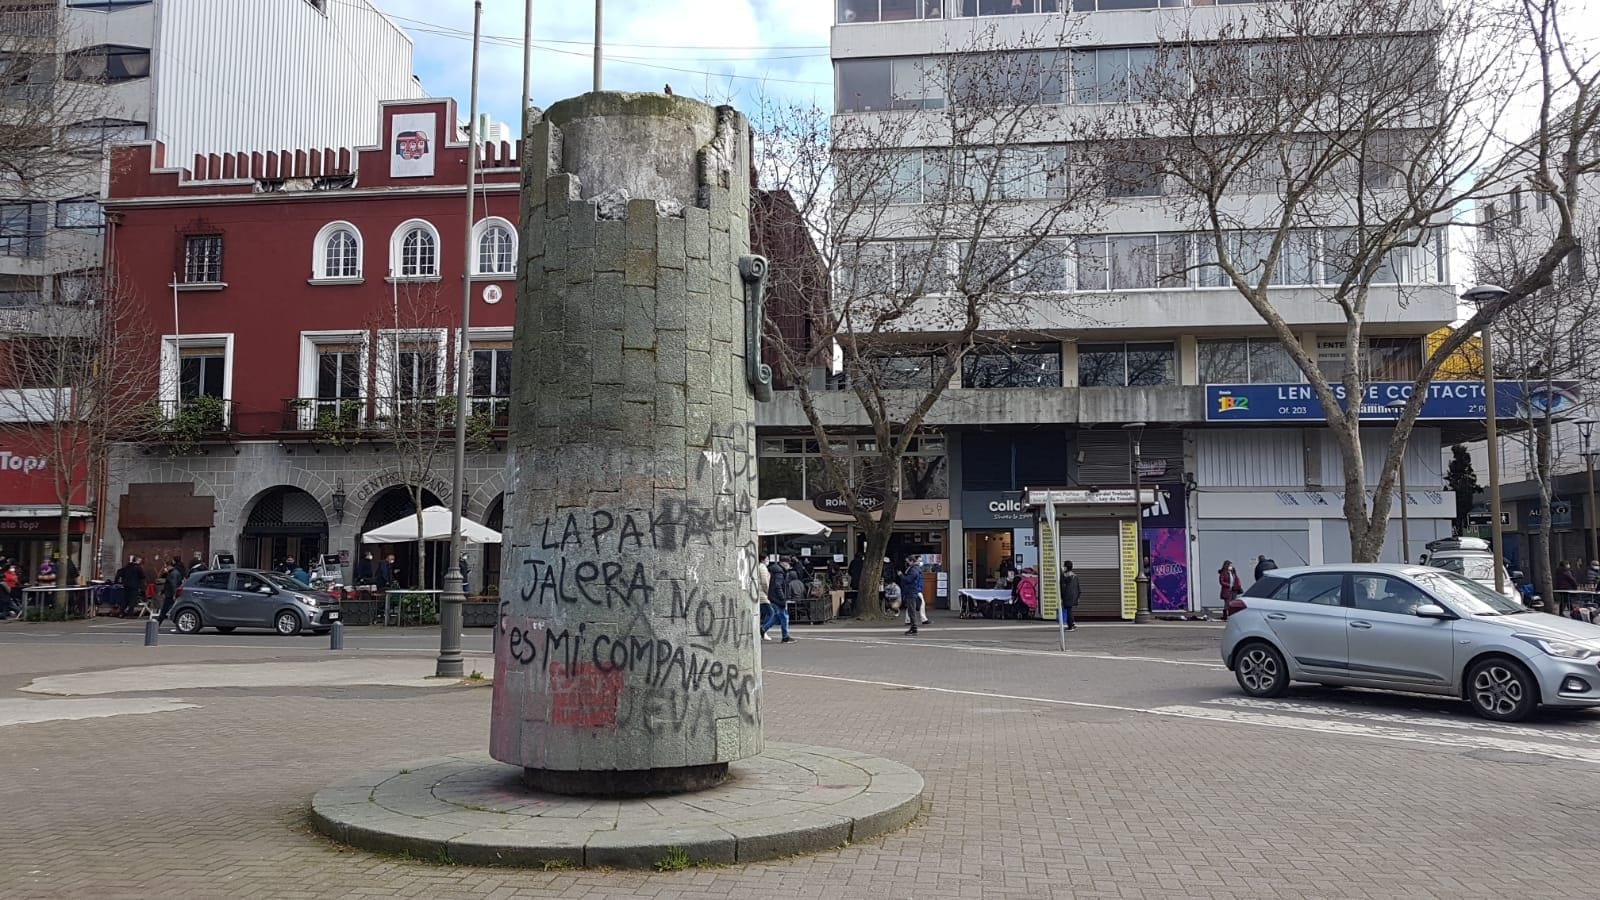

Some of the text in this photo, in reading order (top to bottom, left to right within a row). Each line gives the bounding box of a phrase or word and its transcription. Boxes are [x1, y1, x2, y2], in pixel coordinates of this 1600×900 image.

[1278, 386, 1346, 400] LENS
[1386, 385, 1487, 399] COTACT
[1292, 406, 1308, 415] 203
[825, 497, 876, 507] ROMSCH
